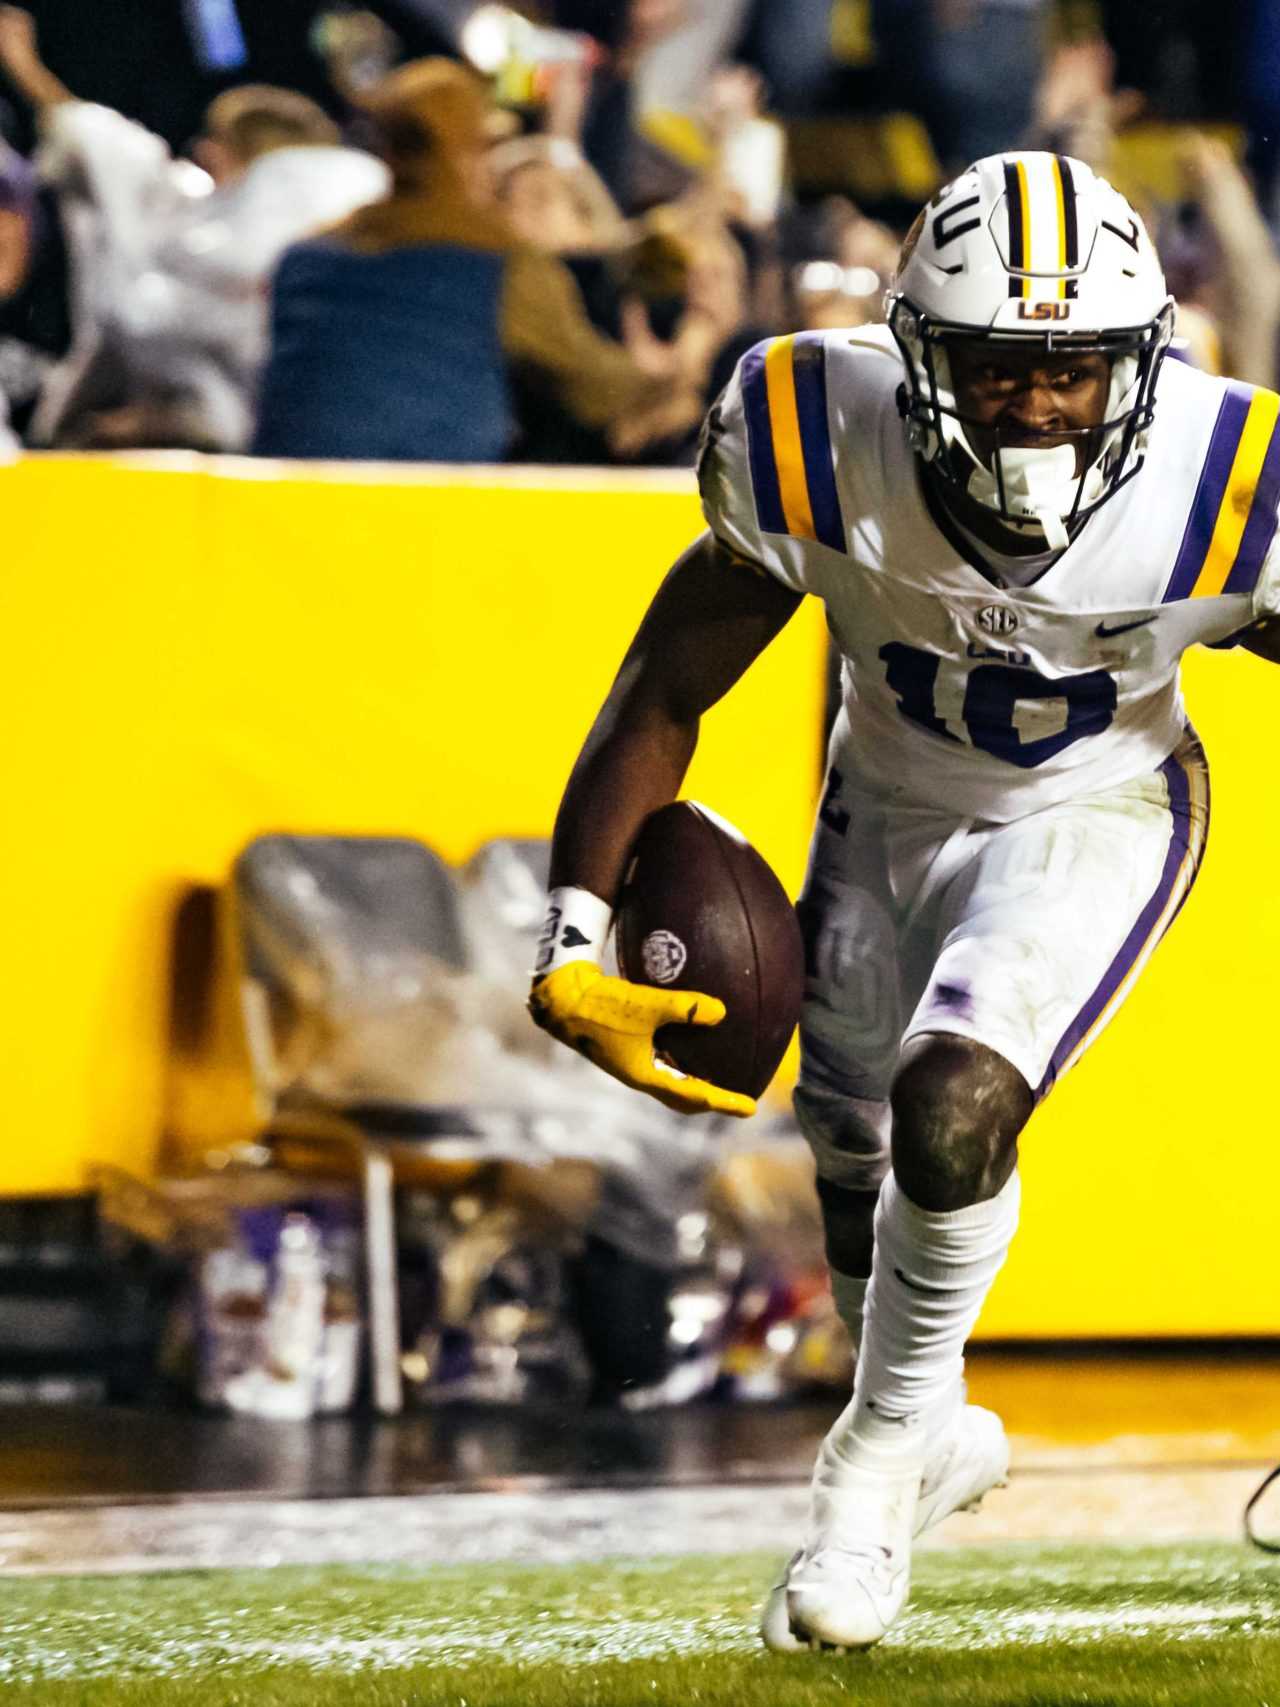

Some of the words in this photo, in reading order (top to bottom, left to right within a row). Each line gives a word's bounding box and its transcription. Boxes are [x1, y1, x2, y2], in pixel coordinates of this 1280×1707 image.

[1018, 302, 1070, 321] LSU
[975, 604, 1019, 635] SEC
[879, 641, 1117, 768] 10
